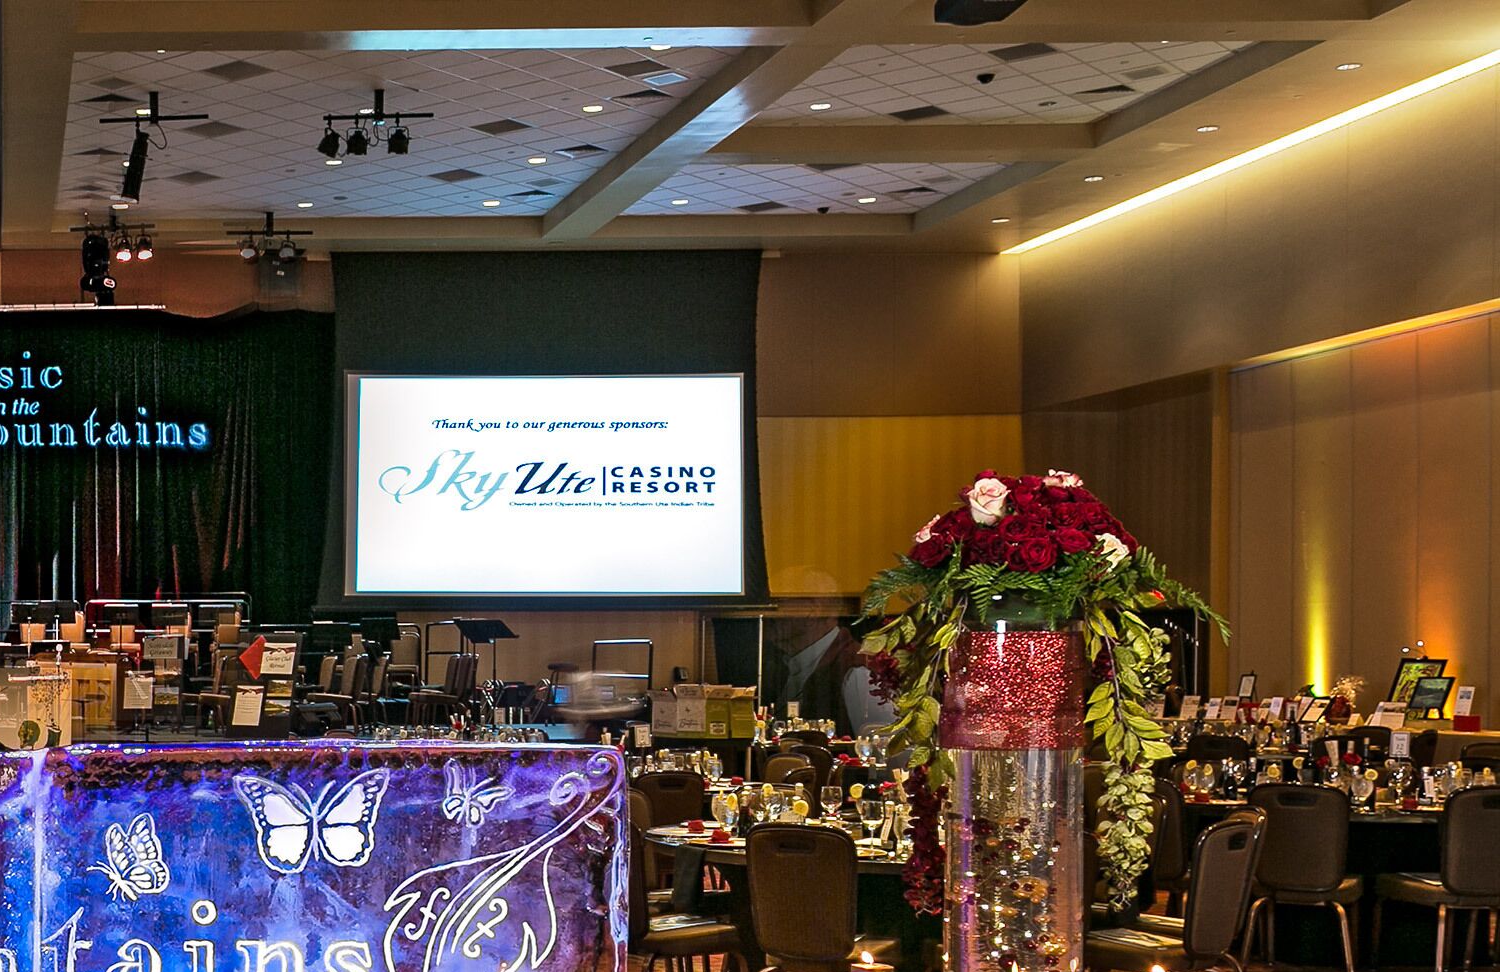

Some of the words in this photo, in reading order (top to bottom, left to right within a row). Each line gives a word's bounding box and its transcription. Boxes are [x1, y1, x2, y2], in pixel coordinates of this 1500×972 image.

[11, 397, 41, 417] the
[431, 418, 474, 431] Thank
[477, 421, 501, 433] you
[505, 420, 519, 430] to
[522, 421, 545, 430] our
[547, 421, 606, 433] generous
[608, 421, 669, 433] sponsors:
[610, 466, 716, 478] CASINO
[378, 449, 510, 512] Sky
[514, 461, 596, 496] Ute
[612, 481, 716, 494] RESORT
